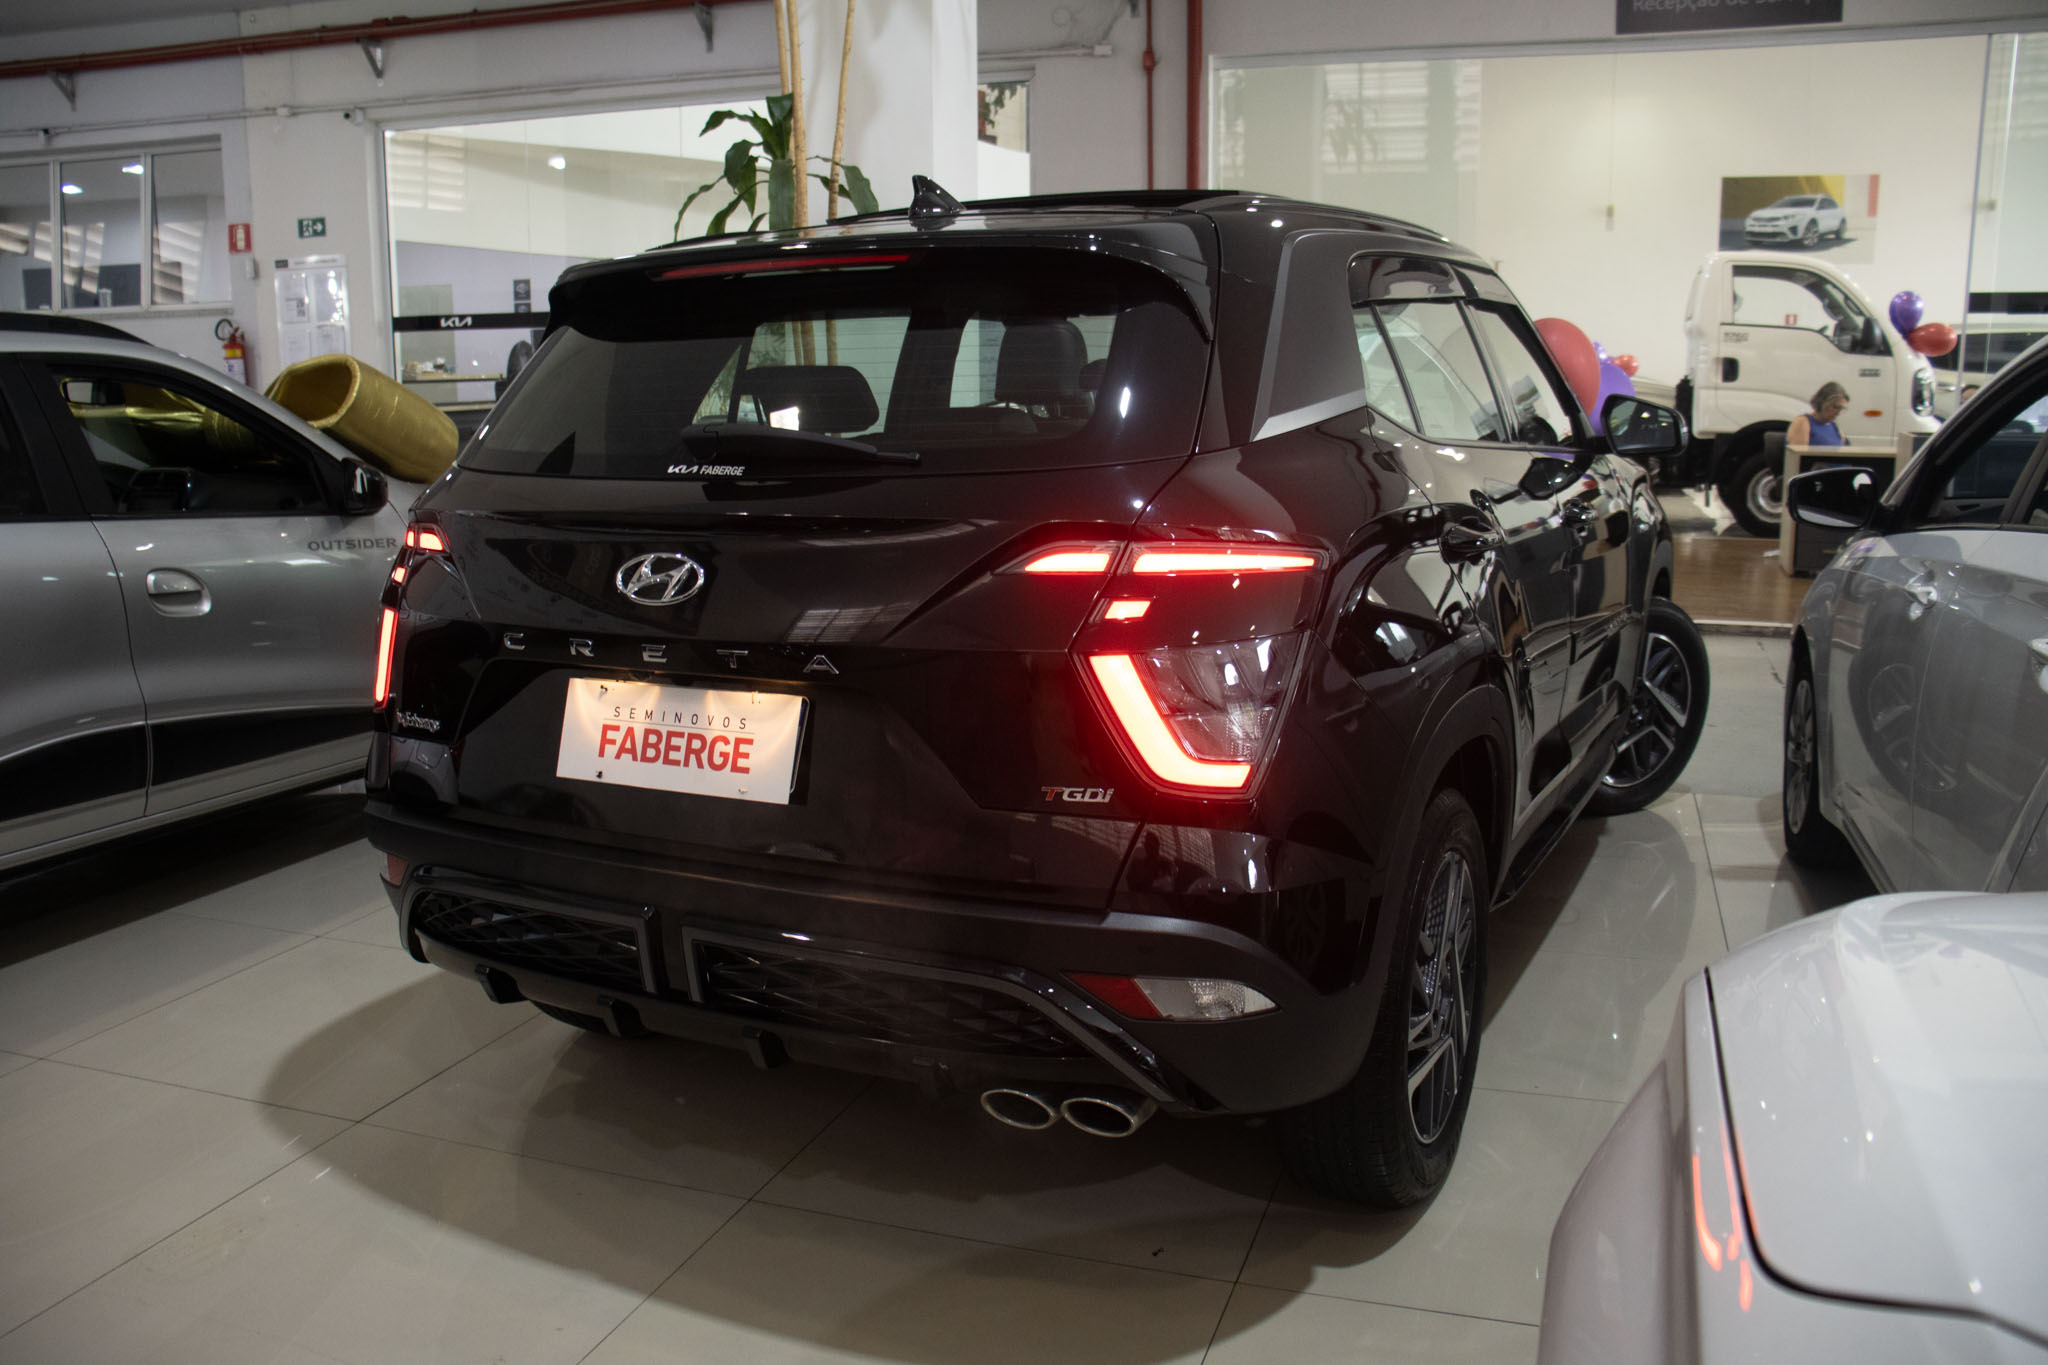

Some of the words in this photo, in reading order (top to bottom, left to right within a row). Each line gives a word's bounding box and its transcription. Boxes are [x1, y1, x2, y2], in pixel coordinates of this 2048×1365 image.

[667, 464, 699, 474] KIA
[700, 465, 746, 476] FABERGE
[307, 537, 398, 551] OUTSIDER
[503, 632, 840, 675] CRETA
[613, 706, 748, 730] SEMINOVOS
[598, 723, 755, 775] FABERGE
